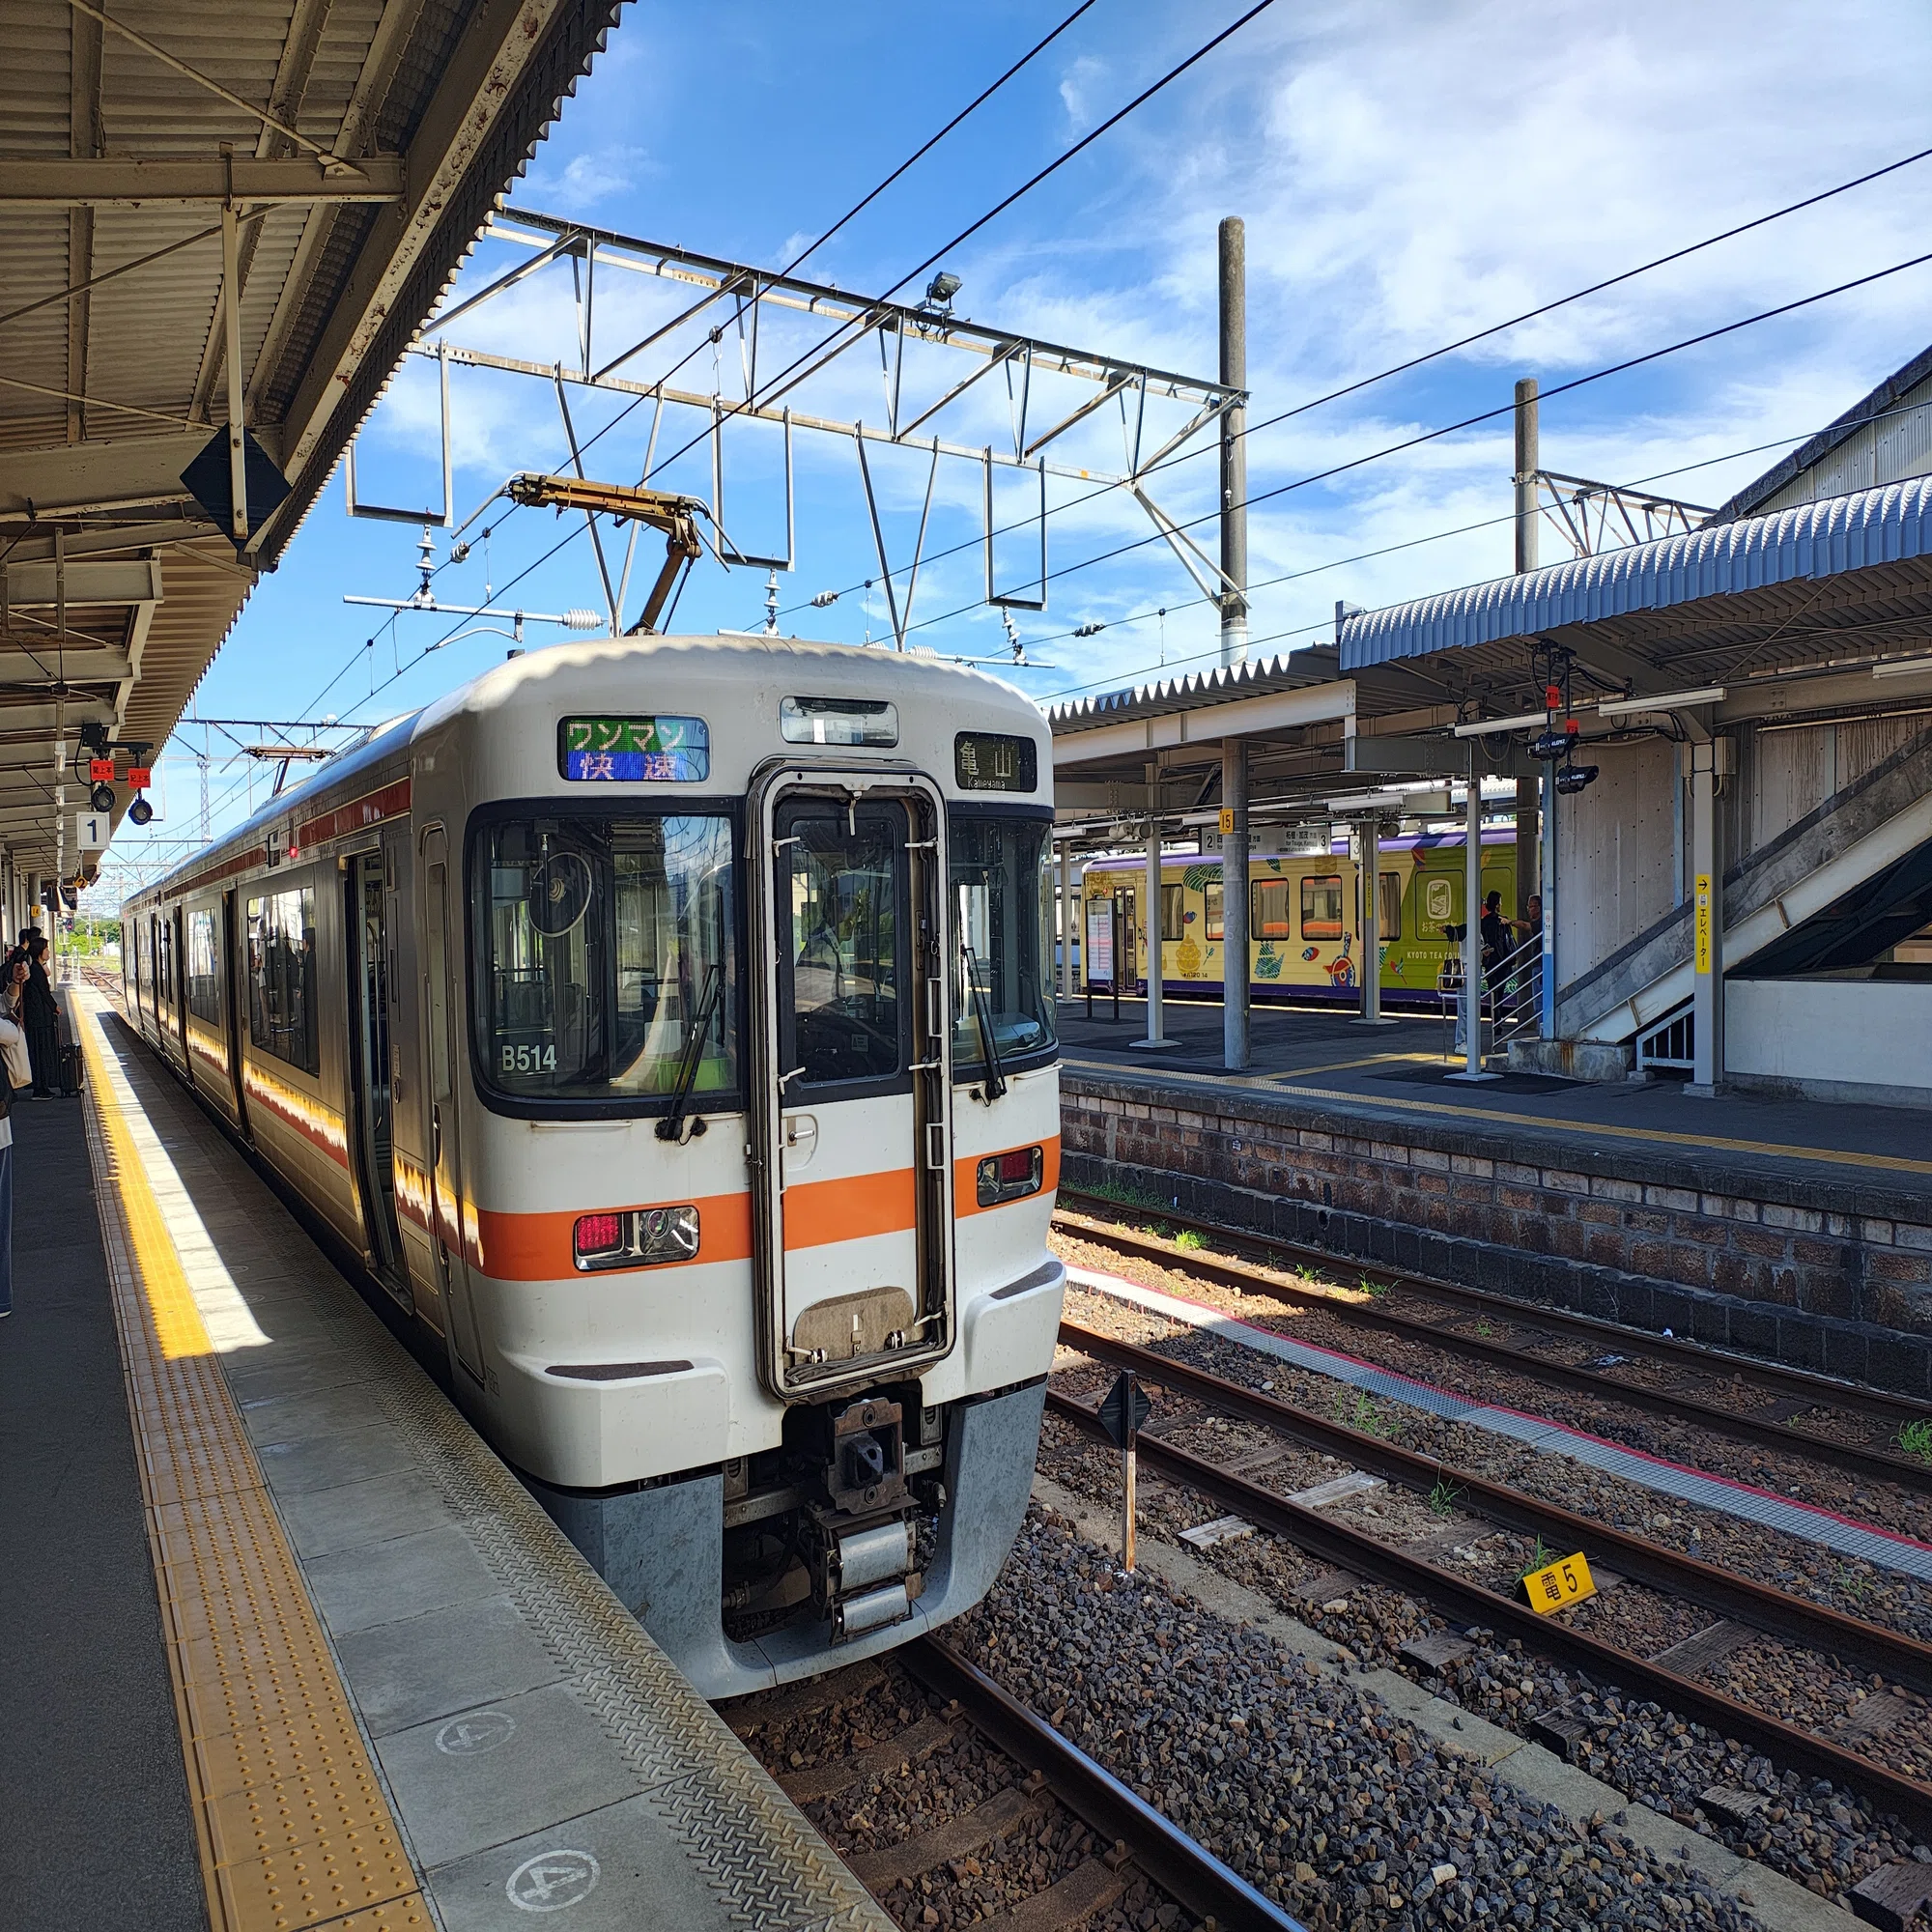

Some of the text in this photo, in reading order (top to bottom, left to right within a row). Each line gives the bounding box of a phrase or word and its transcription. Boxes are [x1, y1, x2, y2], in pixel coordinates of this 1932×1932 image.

[569, 724, 684, 752] ワンマン
[580, 753, 678, 780] 快速
[960, 741, 1011, 777] 亀山
[968, 777, 1006, 789] Kameyama
[87, 819, 97, 842] 1
[1221, 814, 1231, 829] 15
[1207, 835, 1213, 848] 2
[1321, 835, 1326, 847] 3
[77, 878, 85, 888] 2
[501, 1044, 557, 1071] B514
